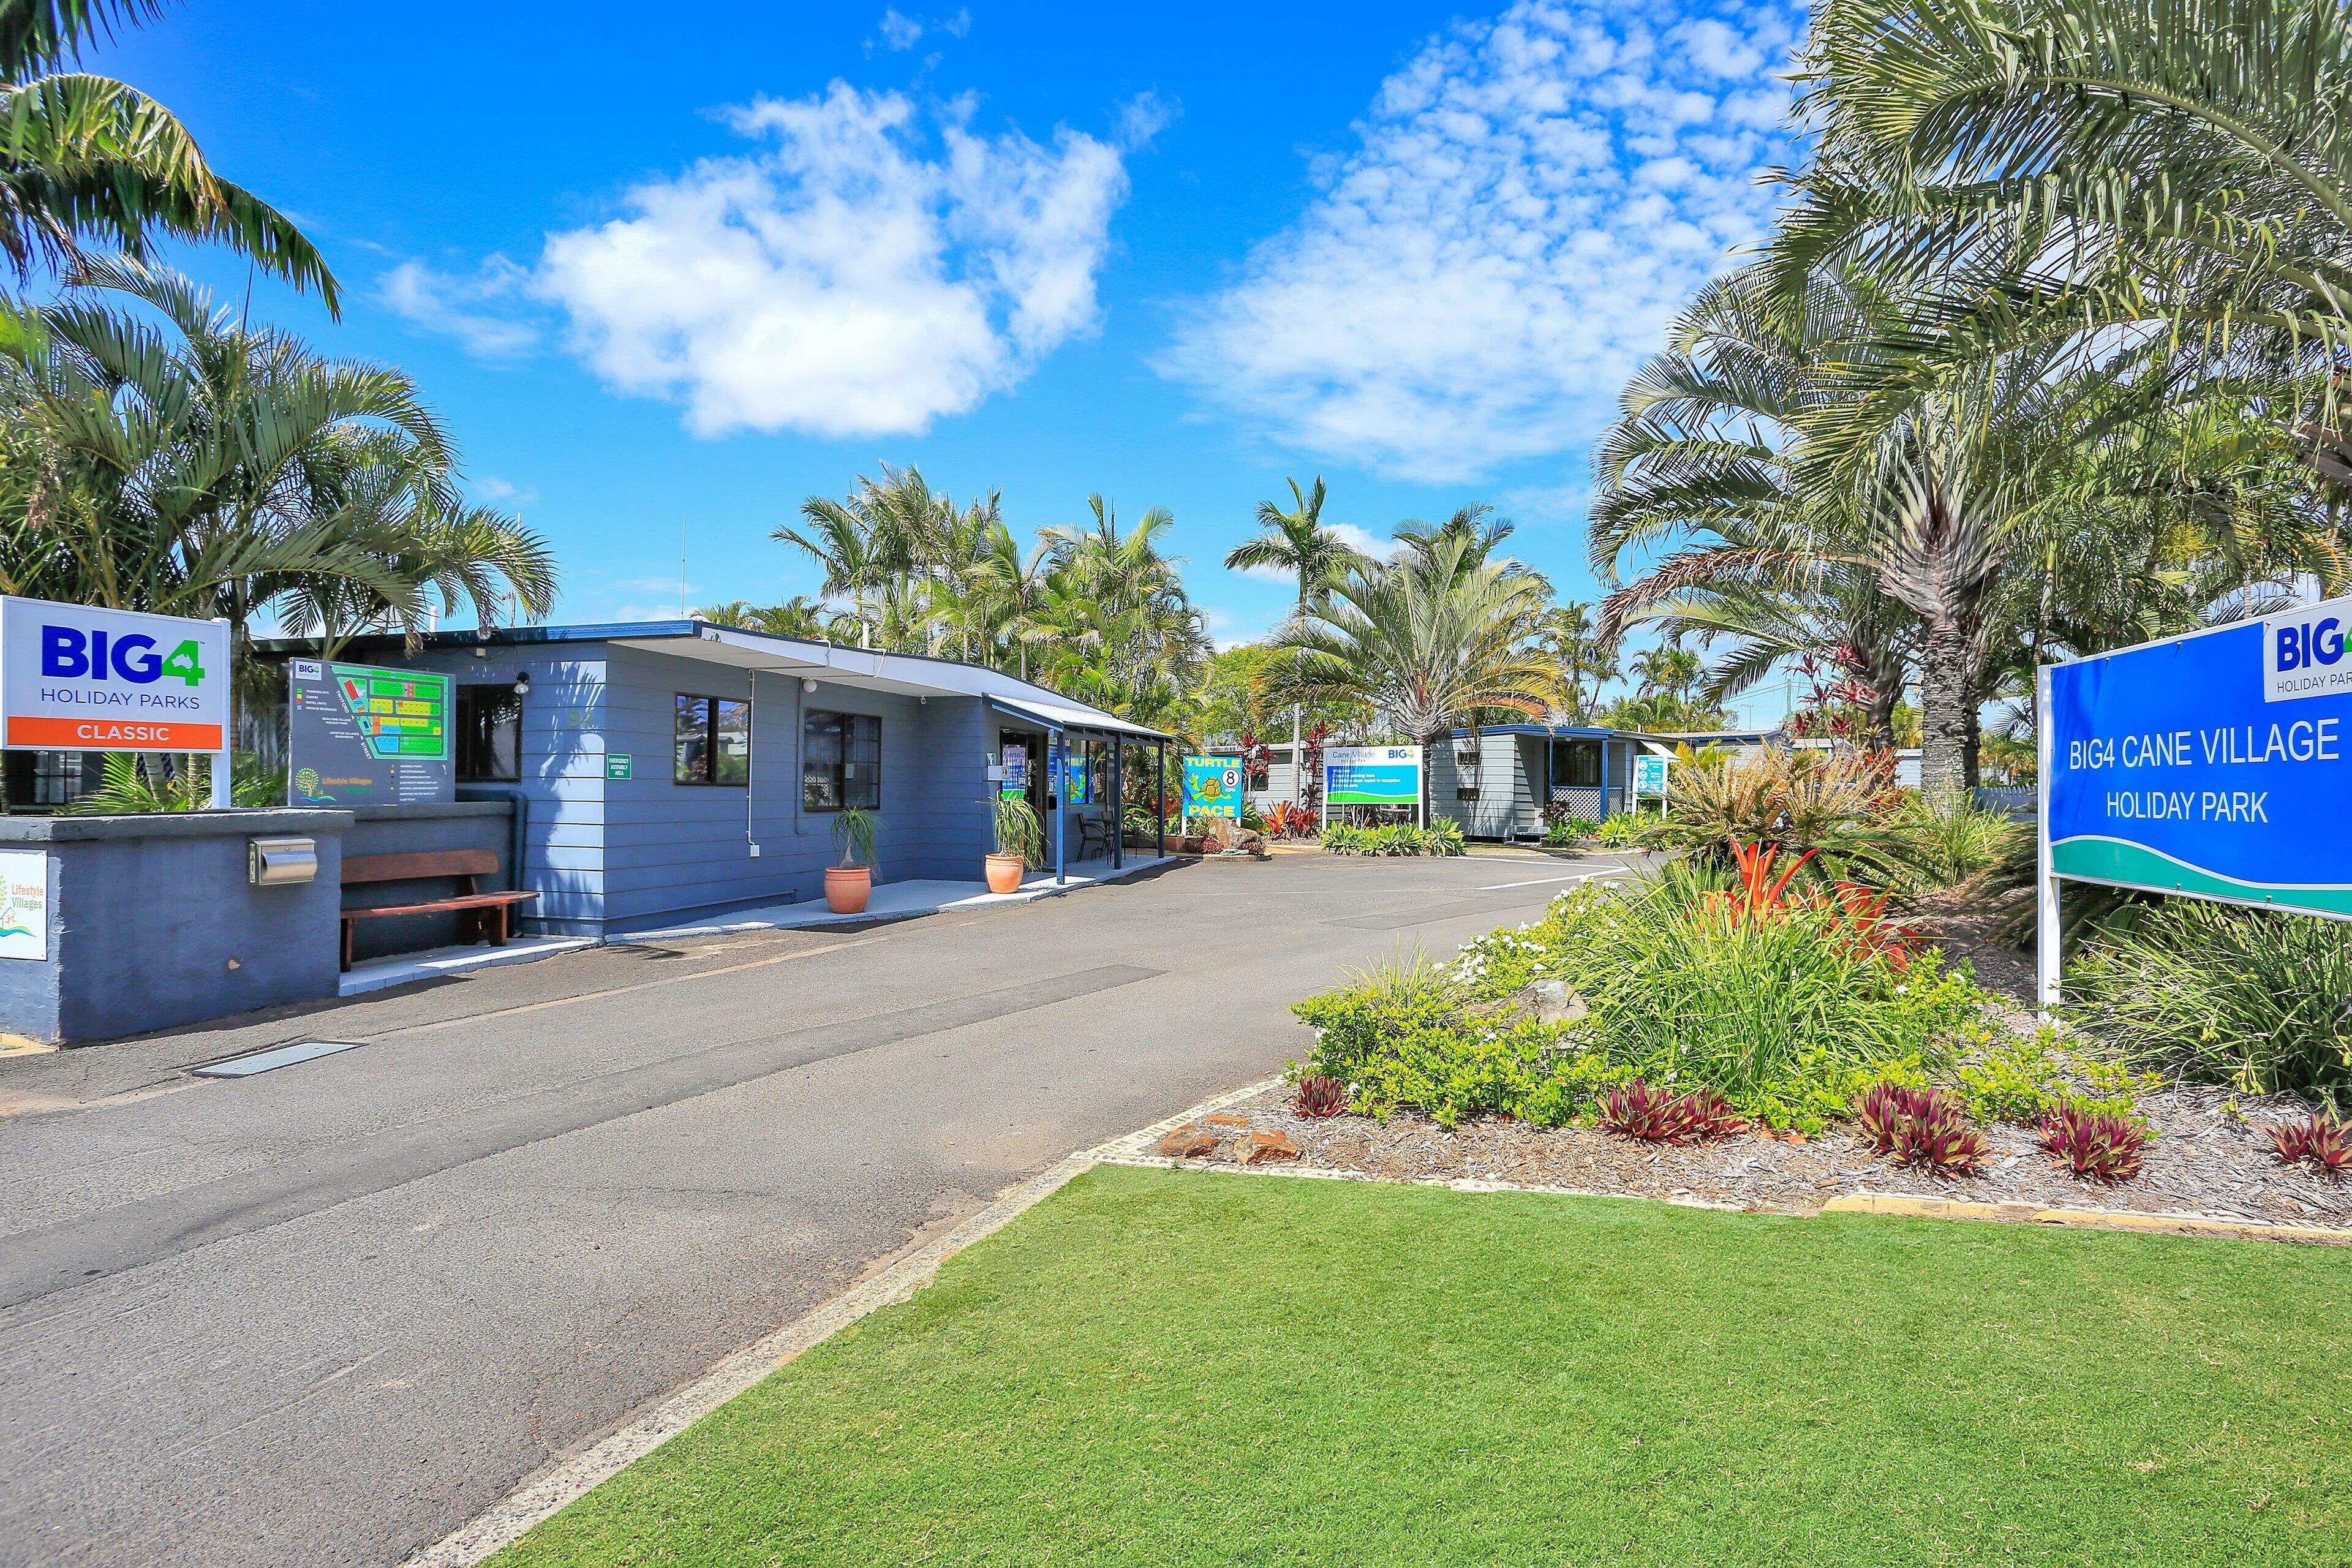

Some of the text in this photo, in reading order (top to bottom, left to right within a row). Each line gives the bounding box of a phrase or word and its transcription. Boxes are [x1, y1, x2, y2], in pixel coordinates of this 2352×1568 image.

[42, 625, 205, 686] BIG4
[2277, 676, 2326, 693] HOLIDAY
[42, 688, 200, 709] HOLIDAY PARKS
[336, 690, 349, 714] TWYFORD
[568, 710, 593, 727] 94
[77, 725, 170, 741] CLASSIC
[361, 742, 372, 760] STREET
[2070, 718, 2339, 770] BIG4 CANE VILLAGE
[1389, 749, 1414, 758] BIG4
[1185, 758, 1240, 768] TURTLE
[1227, 772, 1234, 785] 8
[1189, 805, 1235, 816] PACE
[2106, 791, 2269, 824] HOLIDAY PARK
[12, 884, 44, 898] Lifestyle
[12, 897, 42, 911] Villages
